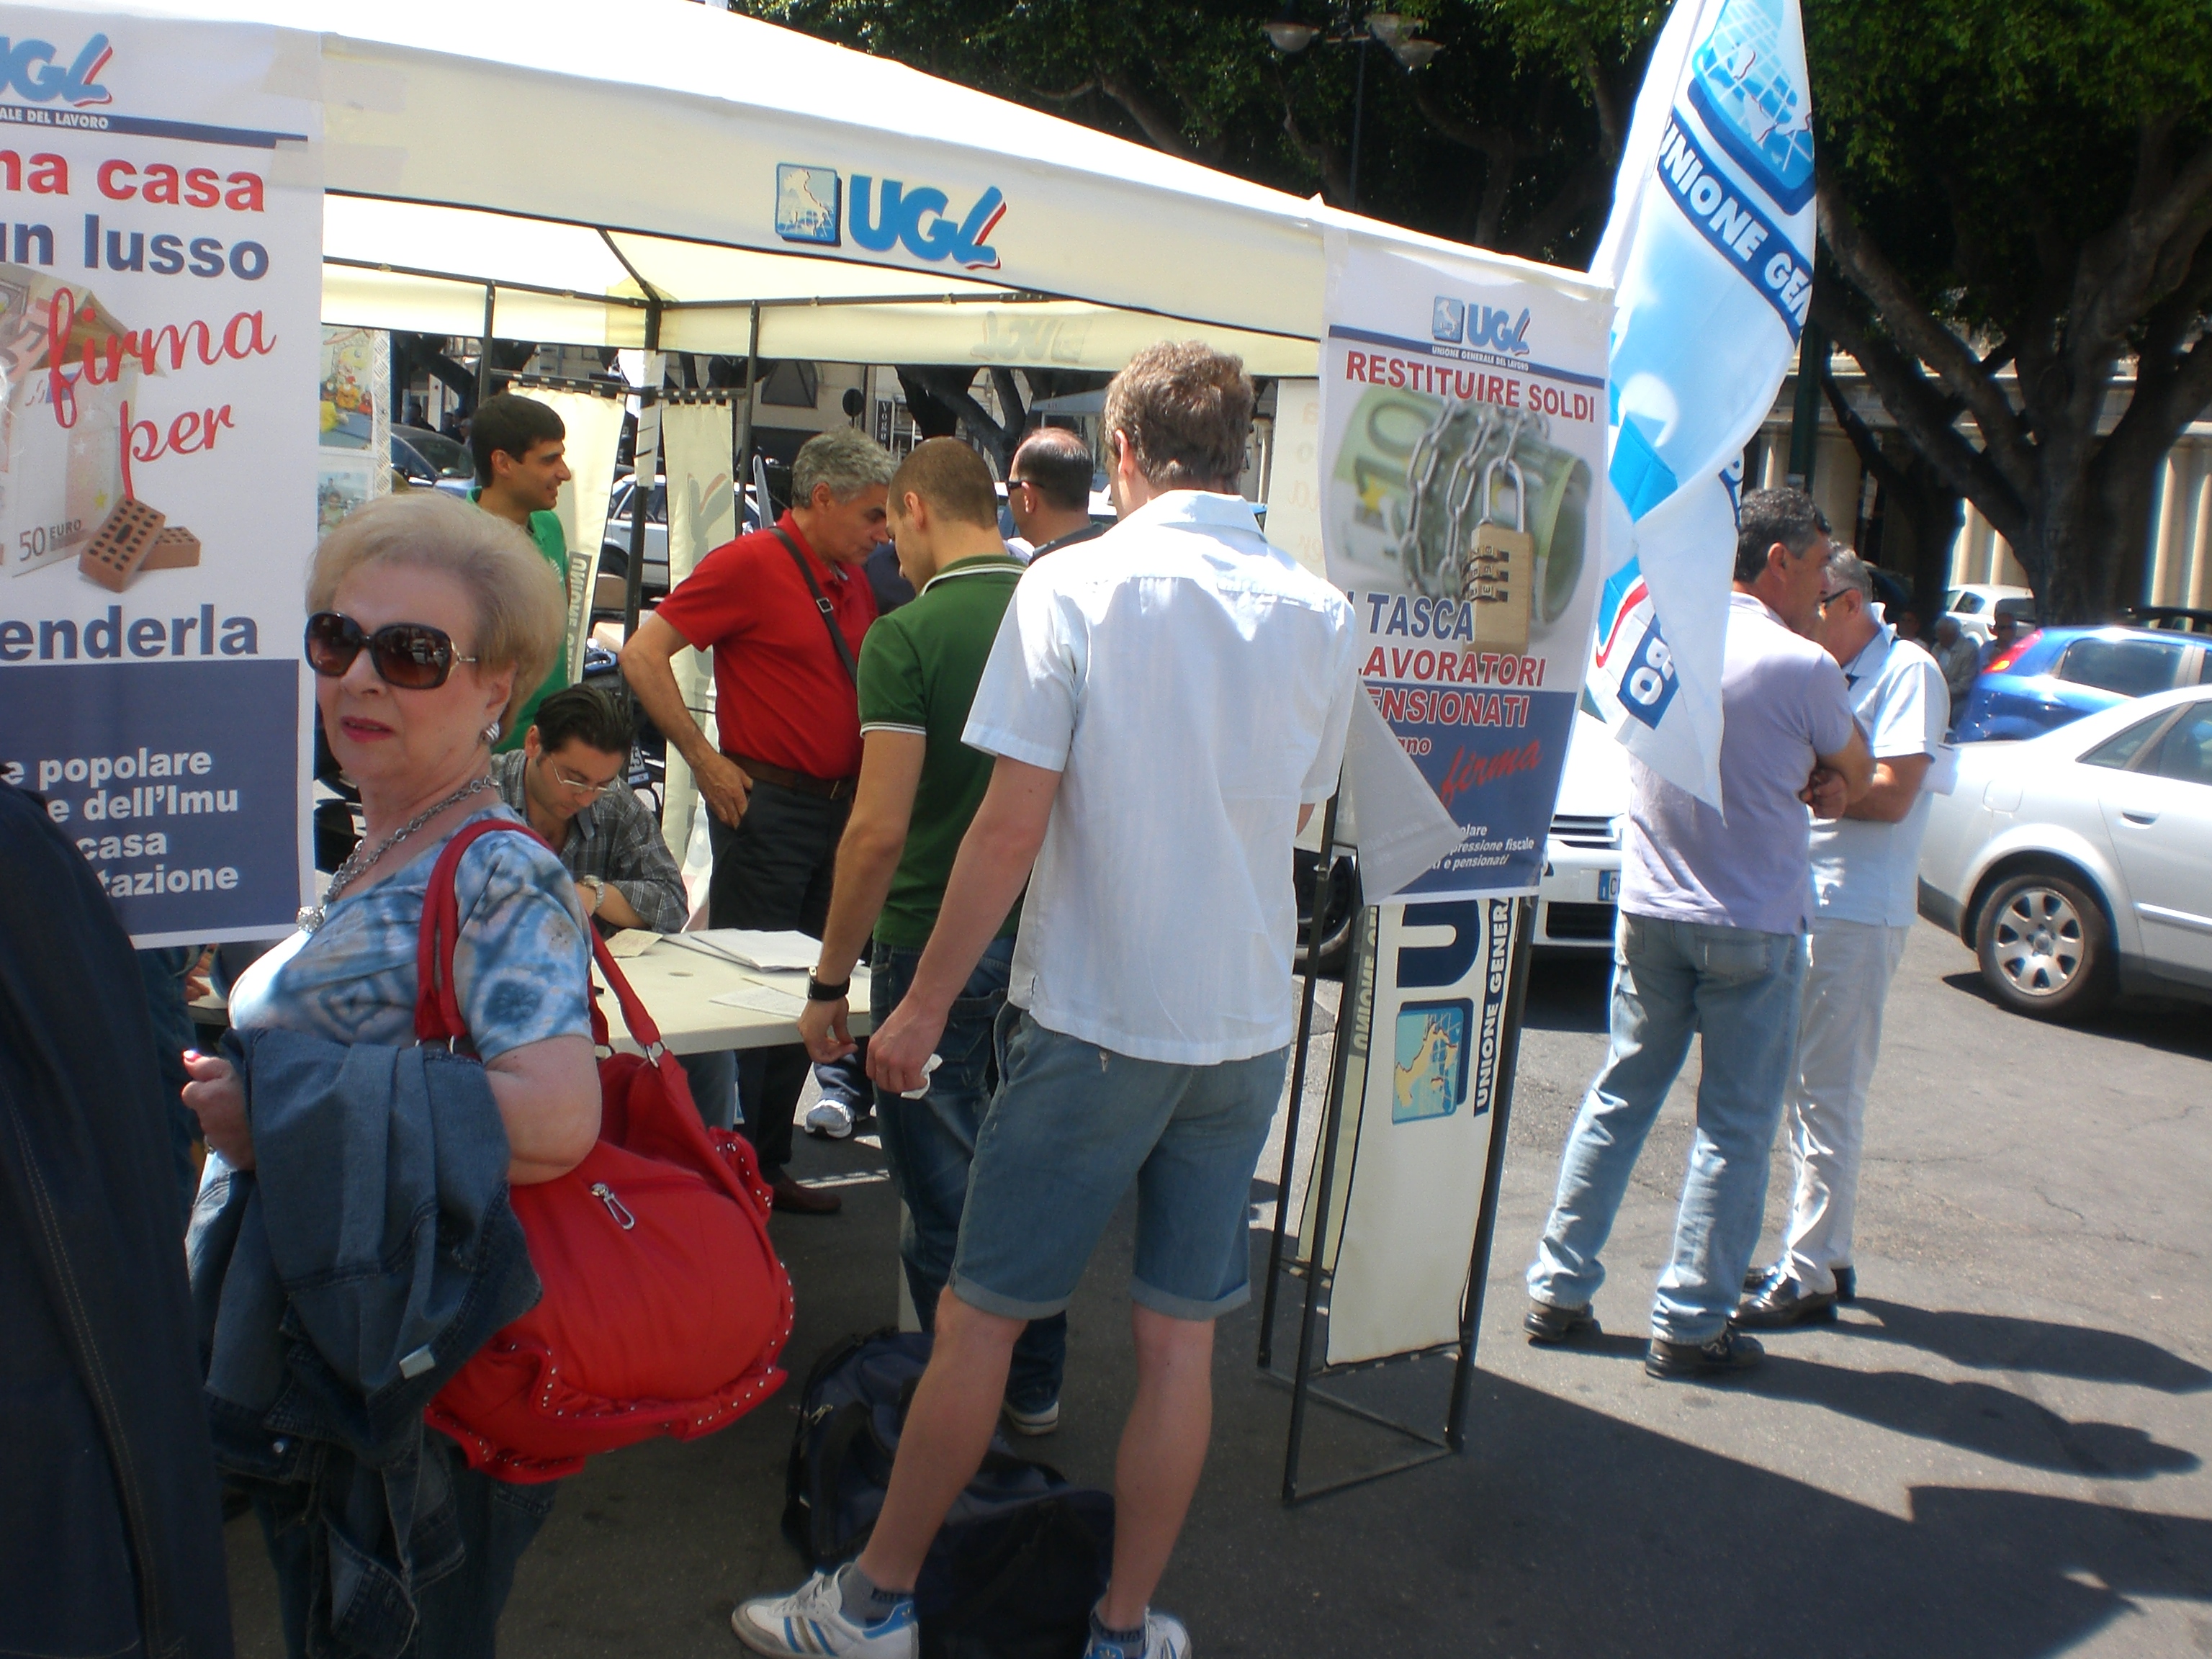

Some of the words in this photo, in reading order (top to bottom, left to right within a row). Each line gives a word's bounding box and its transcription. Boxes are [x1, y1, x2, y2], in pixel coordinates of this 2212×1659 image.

[27, 110, 51, 124] DEL
[55, 112, 108, 129] LAVORO
[97, 158, 264, 212] casa
[84, 214, 269, 280] lusso
[848, 173, 1007, 270] UGL
[1431, 346, 1460, 359] UNIONE
[1466, 302, 1531, 356] UGL
[48, 287, 276, 429] firma
[1346, 350, 1520, 408] RESTITUIRE
[1528, 384, 1595, 423] SOLDI
[120, 400, 235, 499] per
[19, 526, 45, 562] 50
[49, 519, 81, 539] EURO
[0, 604, 258, 661] enderla
[1367, 591, 1475, 643] TASCA
[1358, 645, 1547, 688] AVORATORI
[39, 747, 212, 791] popolare
[1439, 738, 1544, 809] firma
[1452, 854, 1510, 871] pensionati
[1505, 837, 1534, 851] fiscale
[1477, 1003, 1498, 1107] UNIONE
